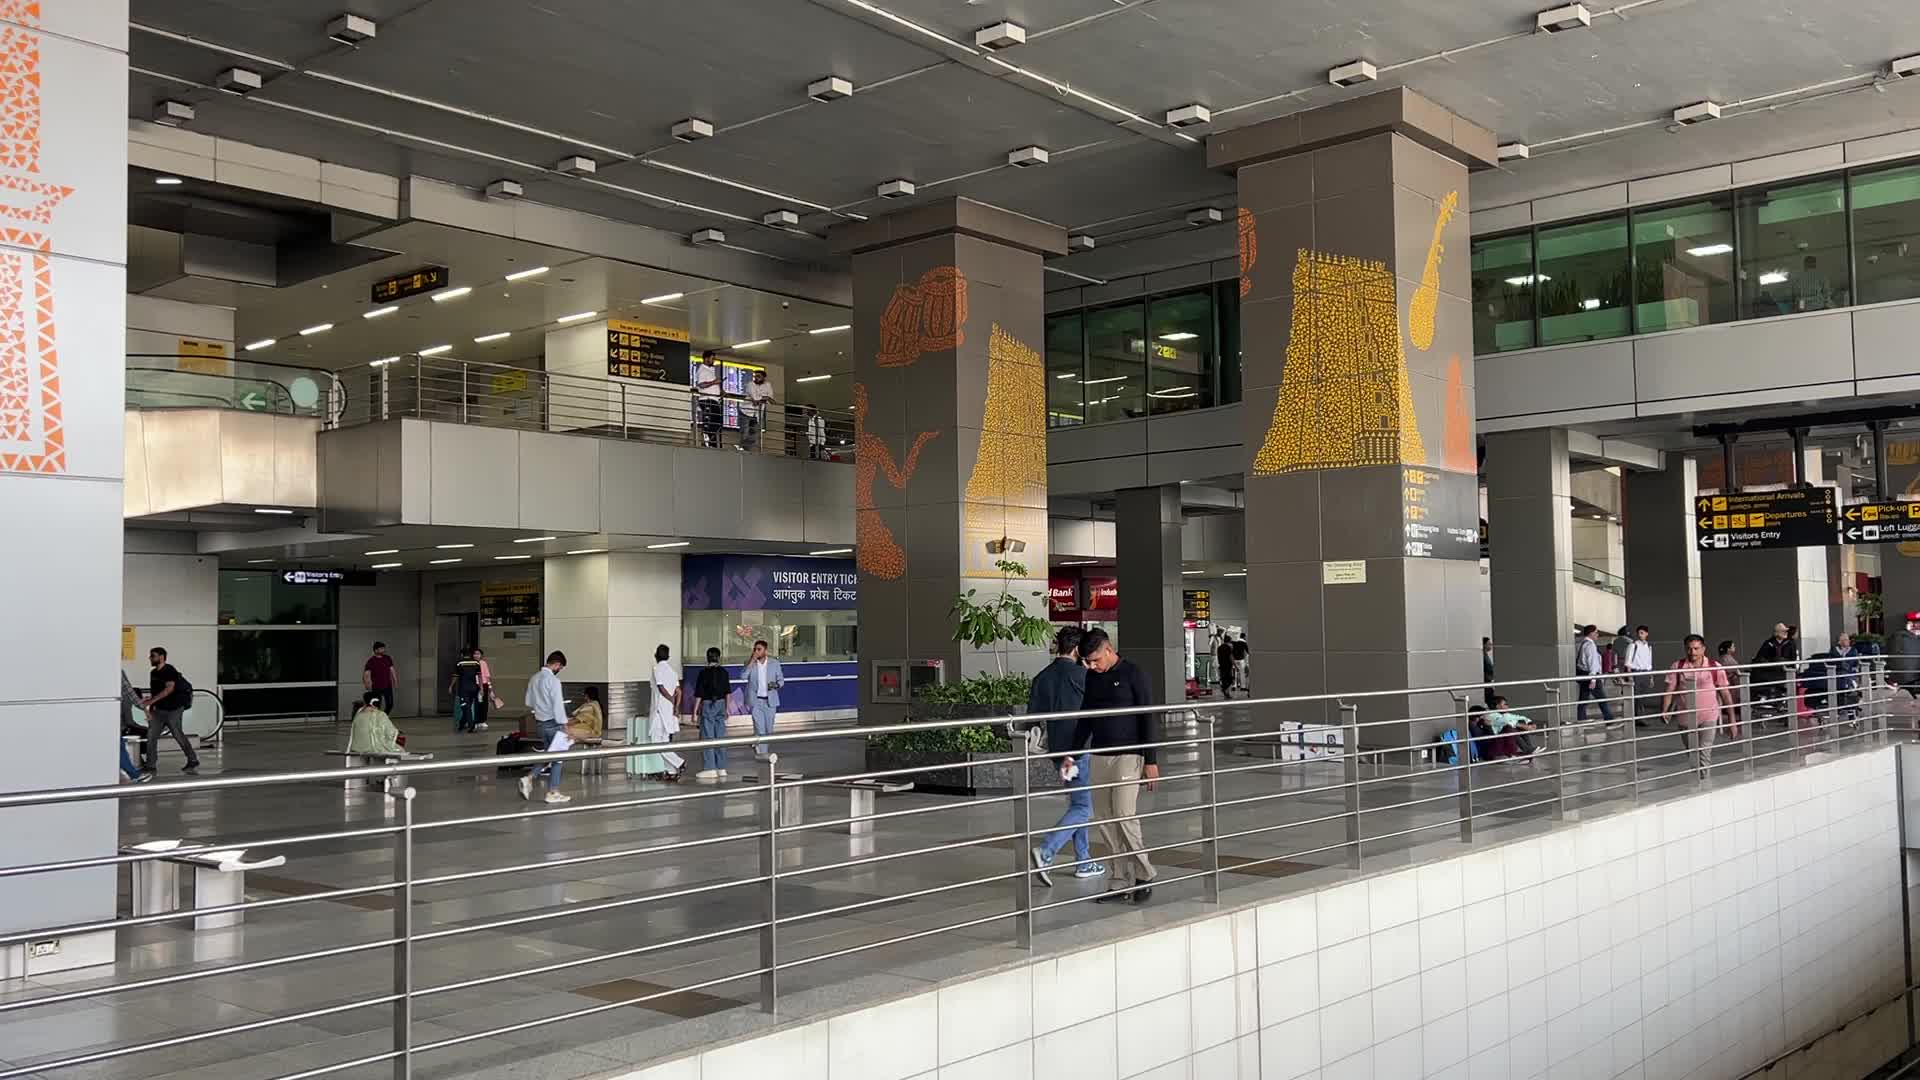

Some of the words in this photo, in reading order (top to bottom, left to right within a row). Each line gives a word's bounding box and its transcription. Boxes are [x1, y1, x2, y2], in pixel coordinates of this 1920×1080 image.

[1728, 494, 1775, 502] International
[1765, 512, 1807, 520] Departures
[773, 572, 809, 583] VISITOR
[811, 573, 838, 584] ENTRY
[773, 586, 806, 604] आगंतुक
[809, 586, 829, 600] प्रवेश
[833, 586, 857, 601] टिकट
[1053, 588, 1074, 597] Bank
